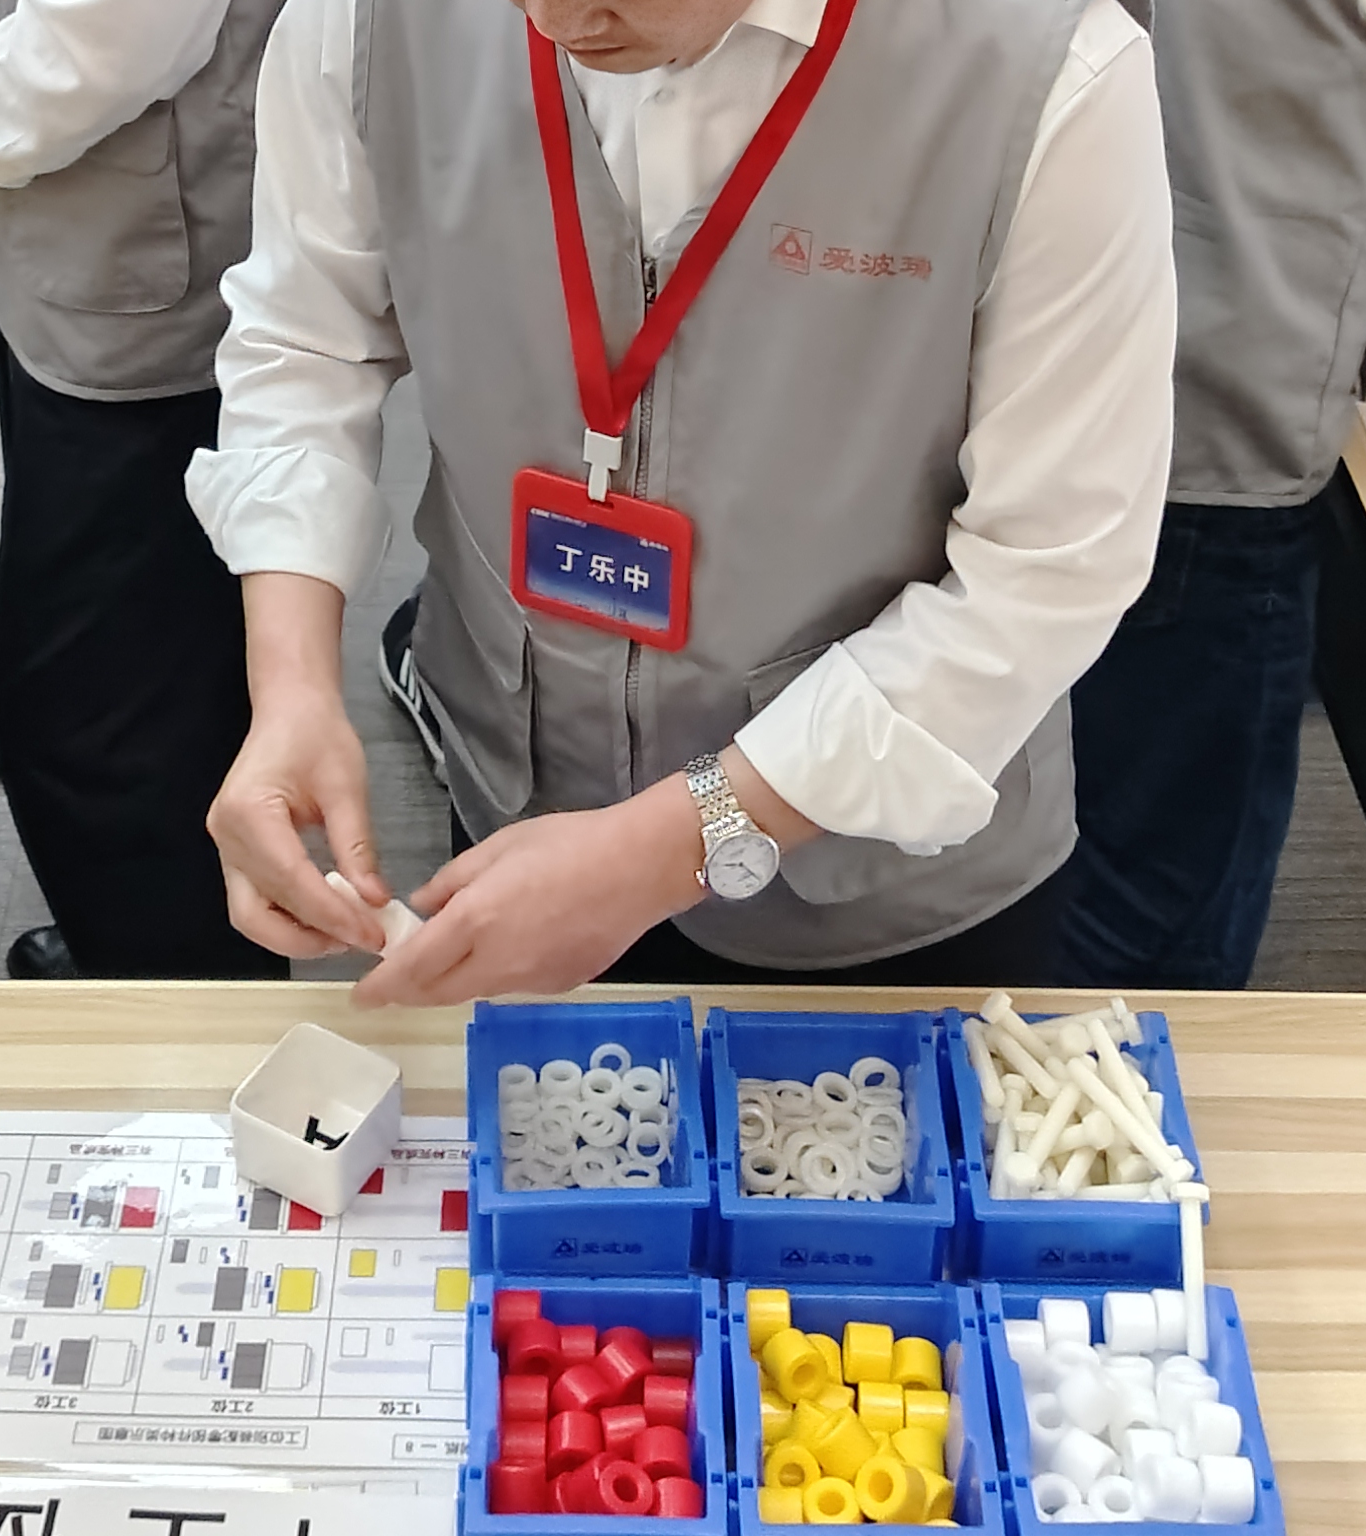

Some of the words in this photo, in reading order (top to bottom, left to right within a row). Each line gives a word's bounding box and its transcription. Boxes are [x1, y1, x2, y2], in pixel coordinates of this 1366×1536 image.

[555, 543, 649, 593] 丁乐中
[33, 1395, 79, 1410] 3工位
[211, 1398, 255, 1415] 2工位
[378, 1400, 422, 1416] 1工位
